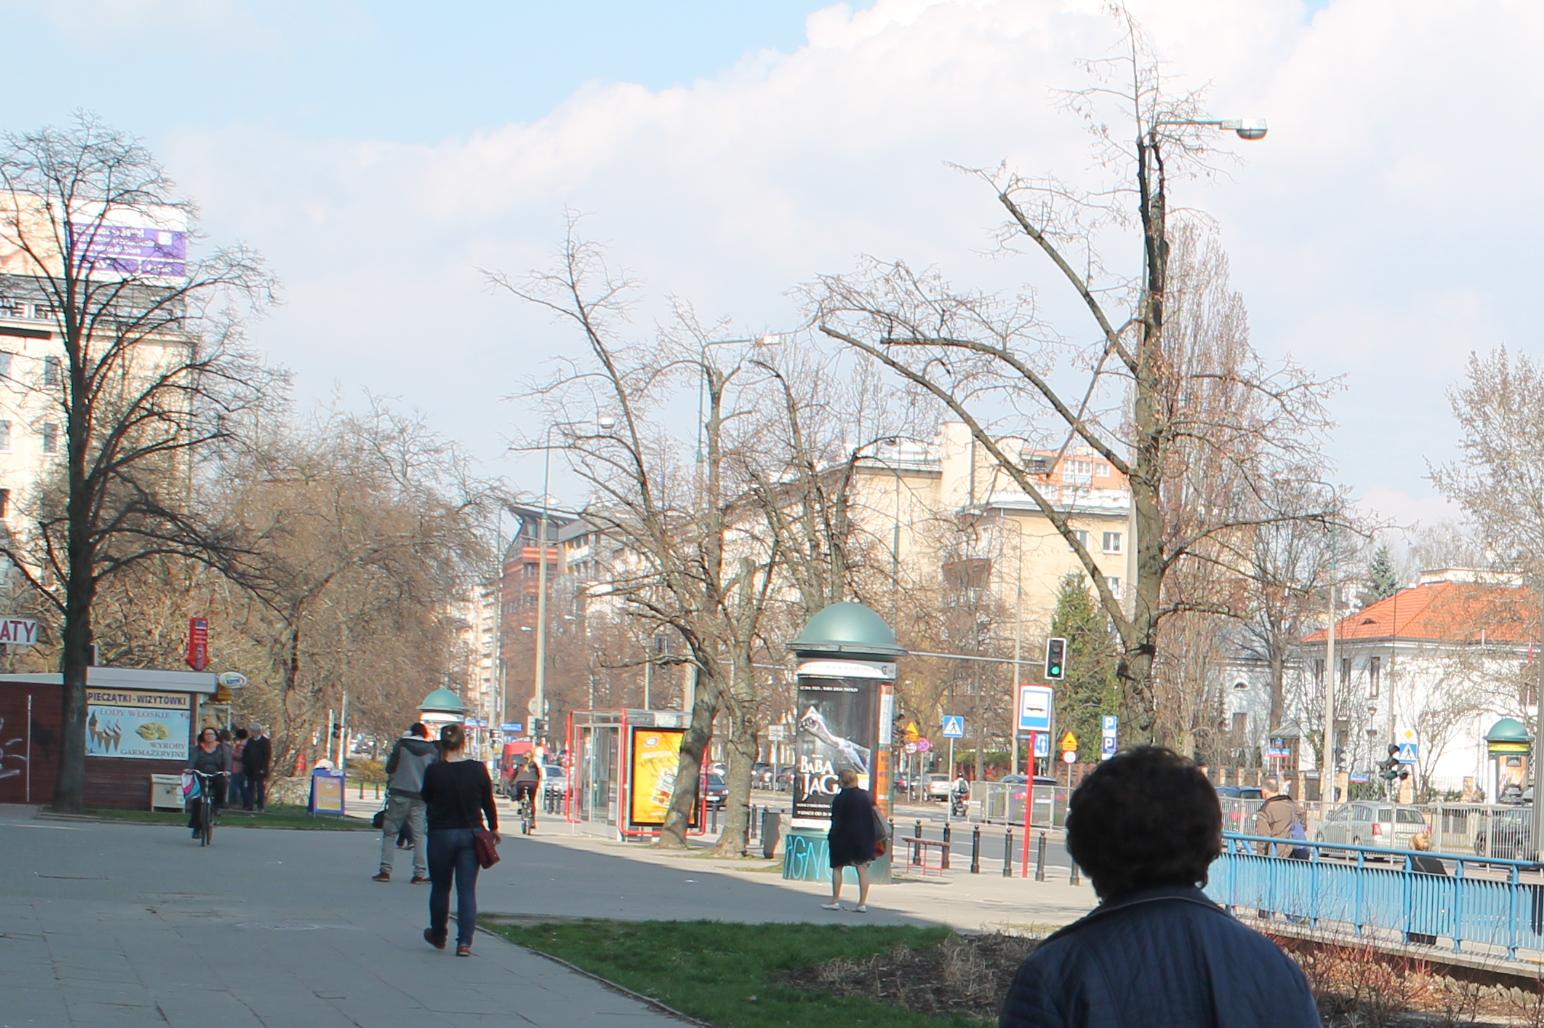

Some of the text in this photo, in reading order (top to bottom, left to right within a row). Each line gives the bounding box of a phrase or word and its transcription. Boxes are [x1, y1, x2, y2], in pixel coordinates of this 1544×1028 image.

[1105, 716, 1114, 729] P
[1105, 737, 1114, 749] P
[800, 755, 835, 775] BABA
[801, 773, 842, 801] JAG
